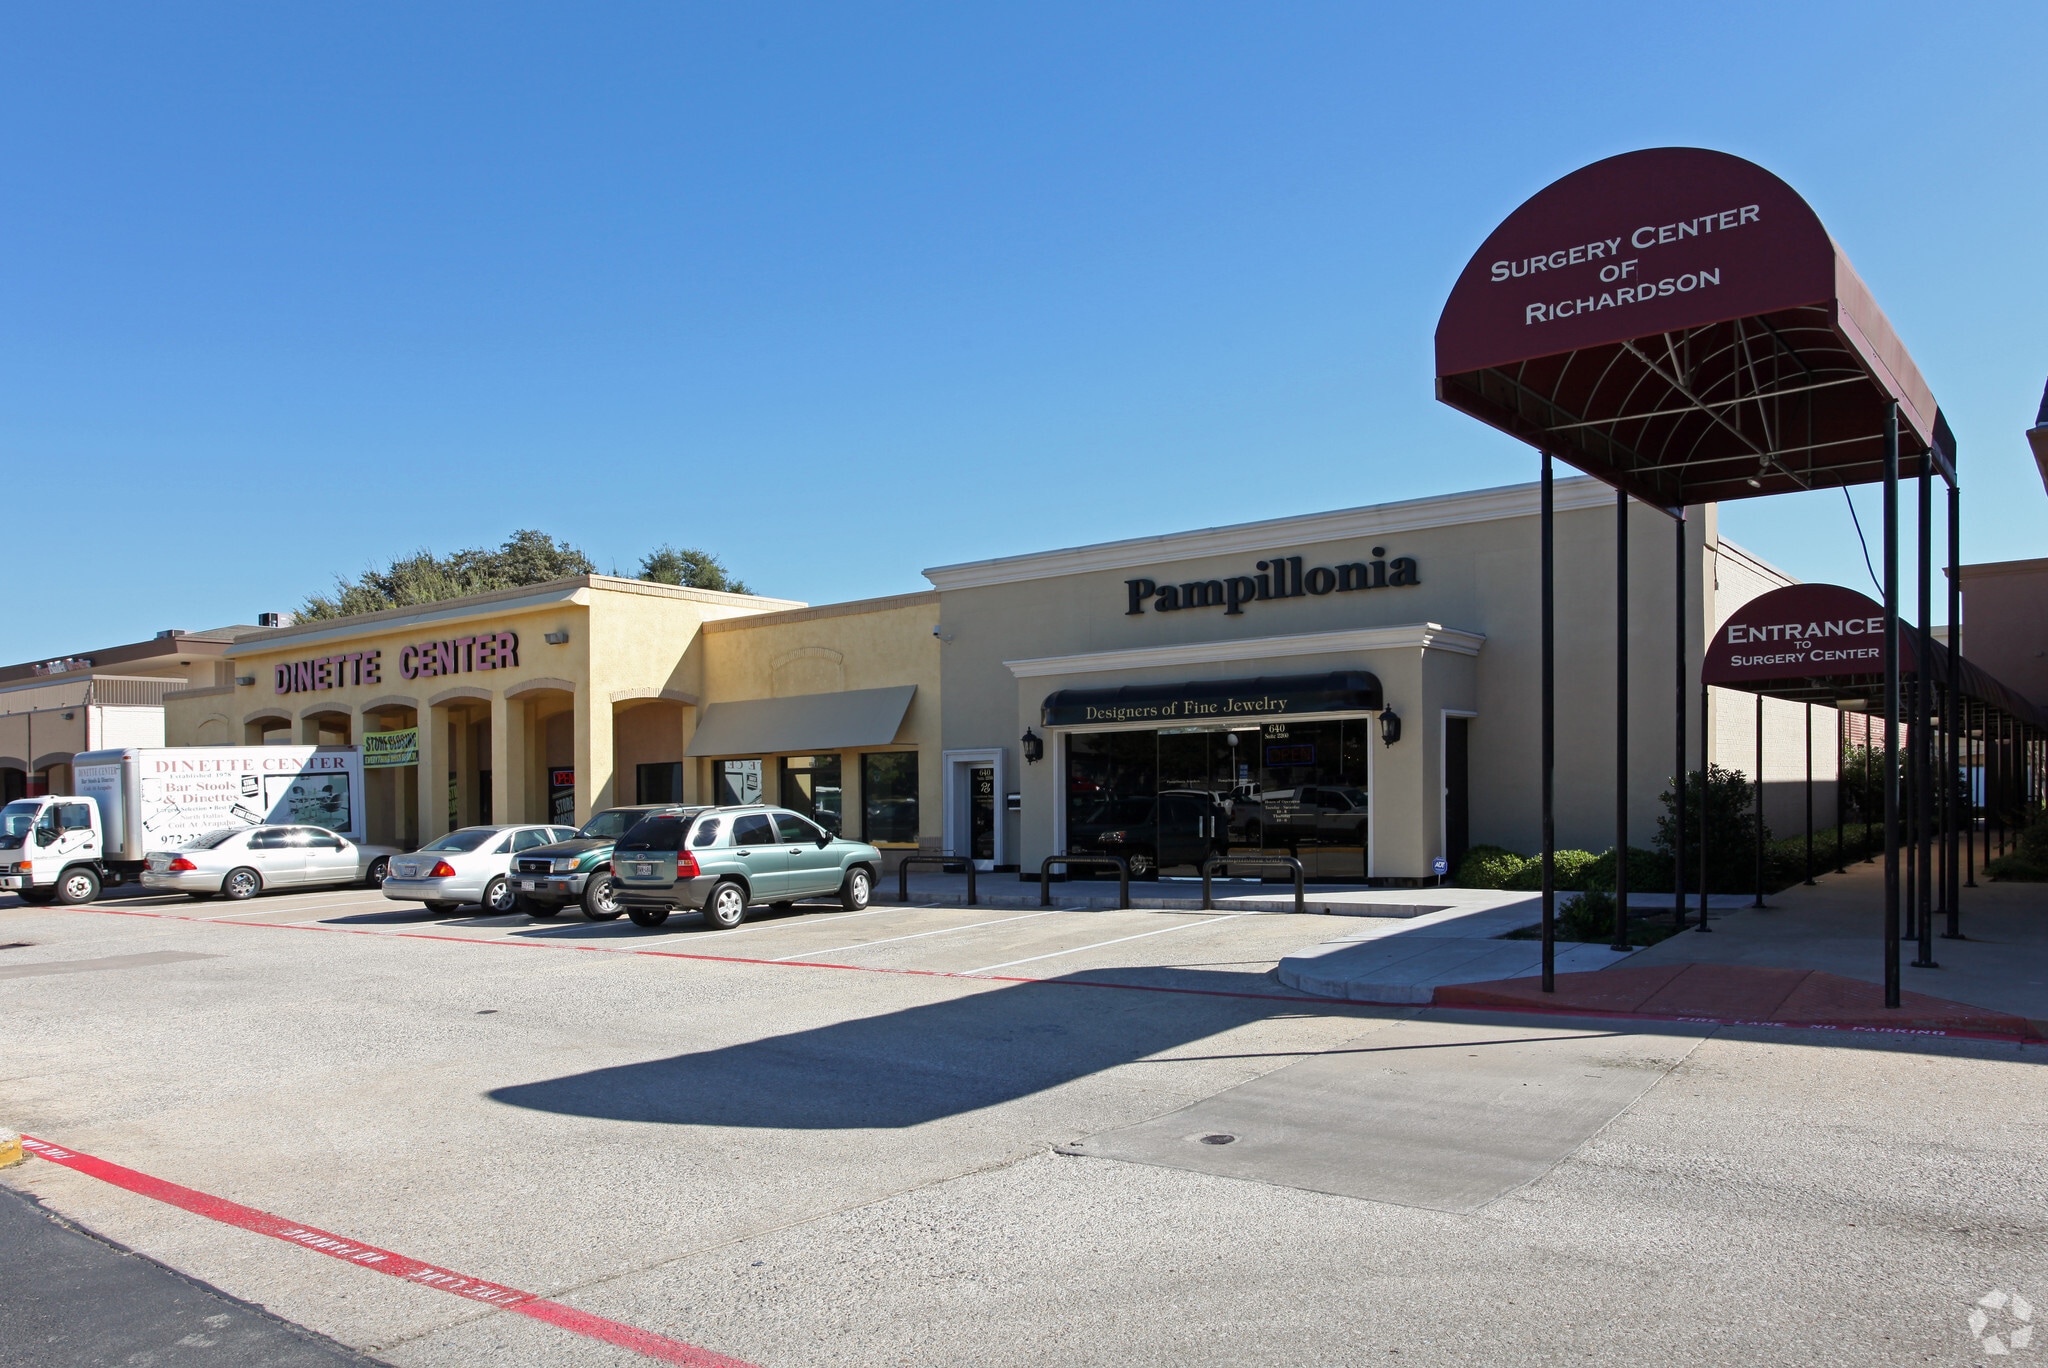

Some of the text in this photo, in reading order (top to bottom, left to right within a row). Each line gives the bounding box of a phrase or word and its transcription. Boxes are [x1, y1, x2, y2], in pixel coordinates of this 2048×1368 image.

[1491, 204, 1760, 282] SURGERY CENTER
[1599, 259, 1638, 283] OF
[1525, 267, 1720, 325] RICHARDSON
[1124, 547, 1420, 615] Pampillonia
[1728, 617, 1884, 644] ENTRANCE
[1794, 641, 1812, 649] TO
[275, 632, 519, 695] DINETTE CENTER
[1731, 649, 1879, 666] SURGERY CENTER
[1086, 696, 1288, 721] Designers of Fine Jewelry
[1269, 724, 1285, 733] 640
[366, 736, 387, 752] STORE
[155, 757, 345, 773] DINETTE CENTER
[166, 783, 191, 792] Bar
[196, 781, 236, 791] Stools
[163, 794, 239, 804] & Dinettes
[1852, 1026, 1946, 1036] PARKING
